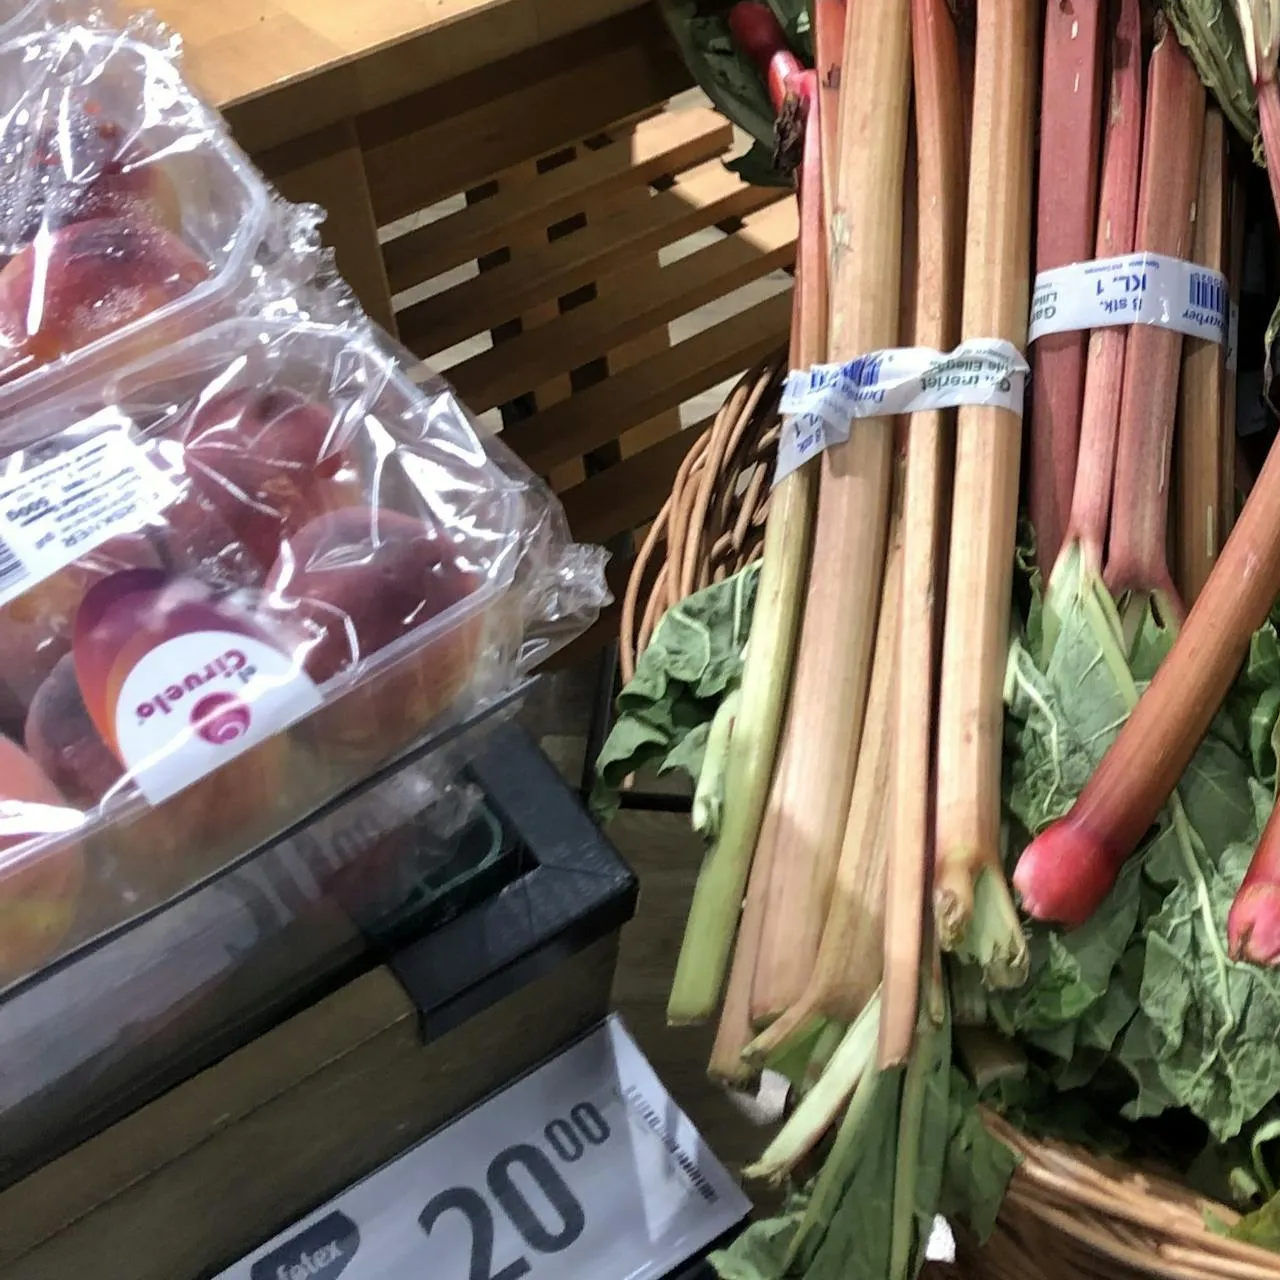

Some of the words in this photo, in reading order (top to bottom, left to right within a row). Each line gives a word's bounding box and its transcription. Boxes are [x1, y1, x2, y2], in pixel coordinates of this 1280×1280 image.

[1095, 279, 1105, 297] 1
[1113, 273, 1148, 293] KL.
[136, 649, 247, 718] Ciruelo
[417, 1143, 586, 1280] 20
[544, 1101, 611, 1163] 00
